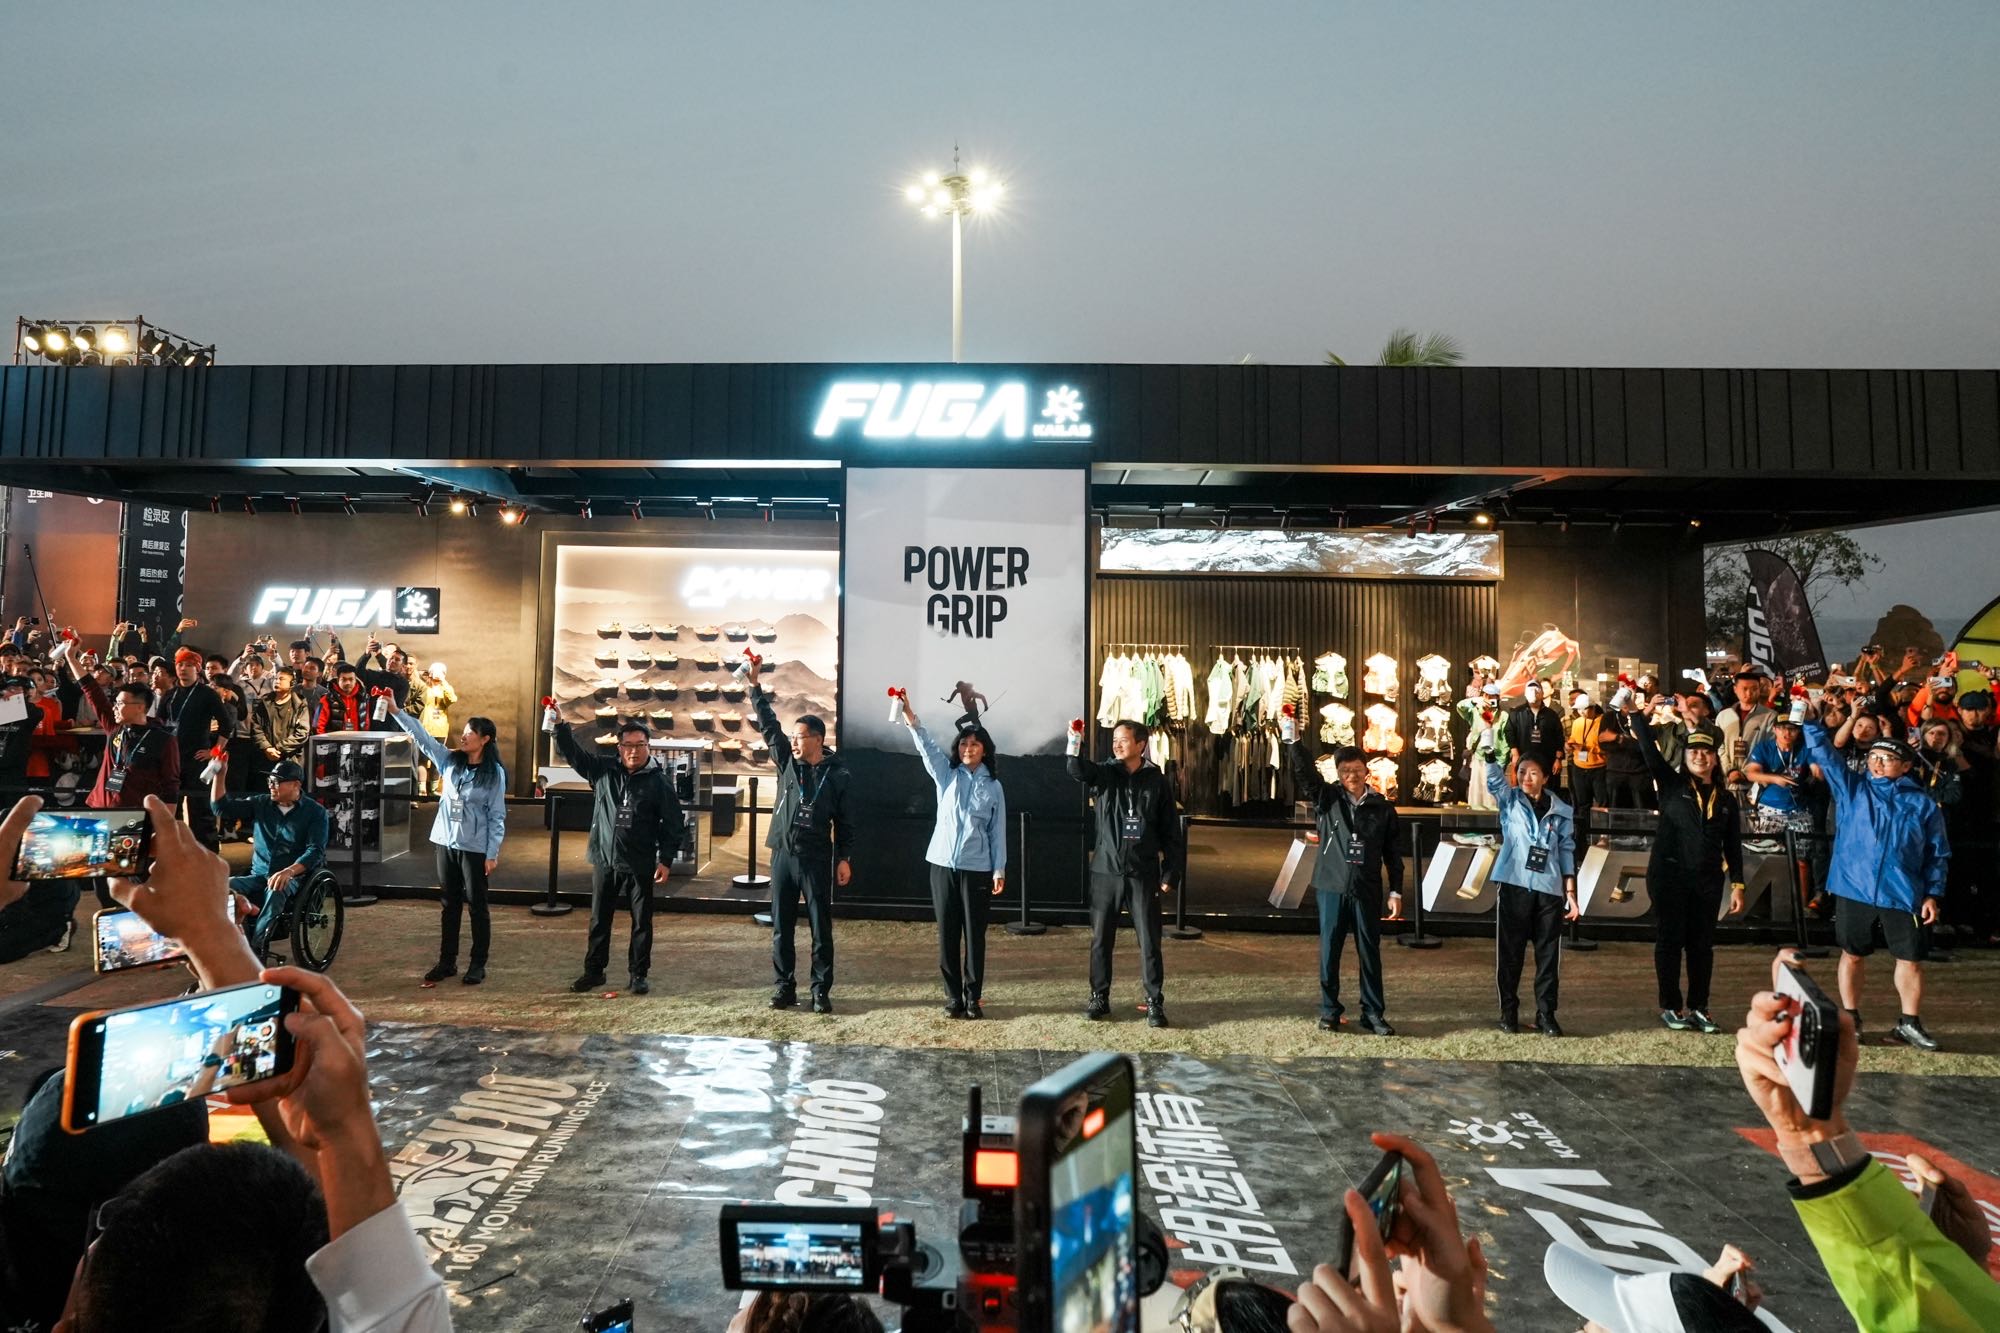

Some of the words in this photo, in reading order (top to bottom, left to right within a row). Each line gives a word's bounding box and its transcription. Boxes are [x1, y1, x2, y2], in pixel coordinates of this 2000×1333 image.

[813, 383, 1025, 437] FUGA
[904, 546, 1029, 591] POWER
[253, 588, 391, 626] FUGA
[927, 594, 1007, 639] GRIP
[1510, 1112, 1581, 1159] KAILAS
[469, 1164, 549, 1240] MOUNTAIN
[532, 1108, 591, 1163] RUNNING
[575, 1080, 611, 1108] RACE
